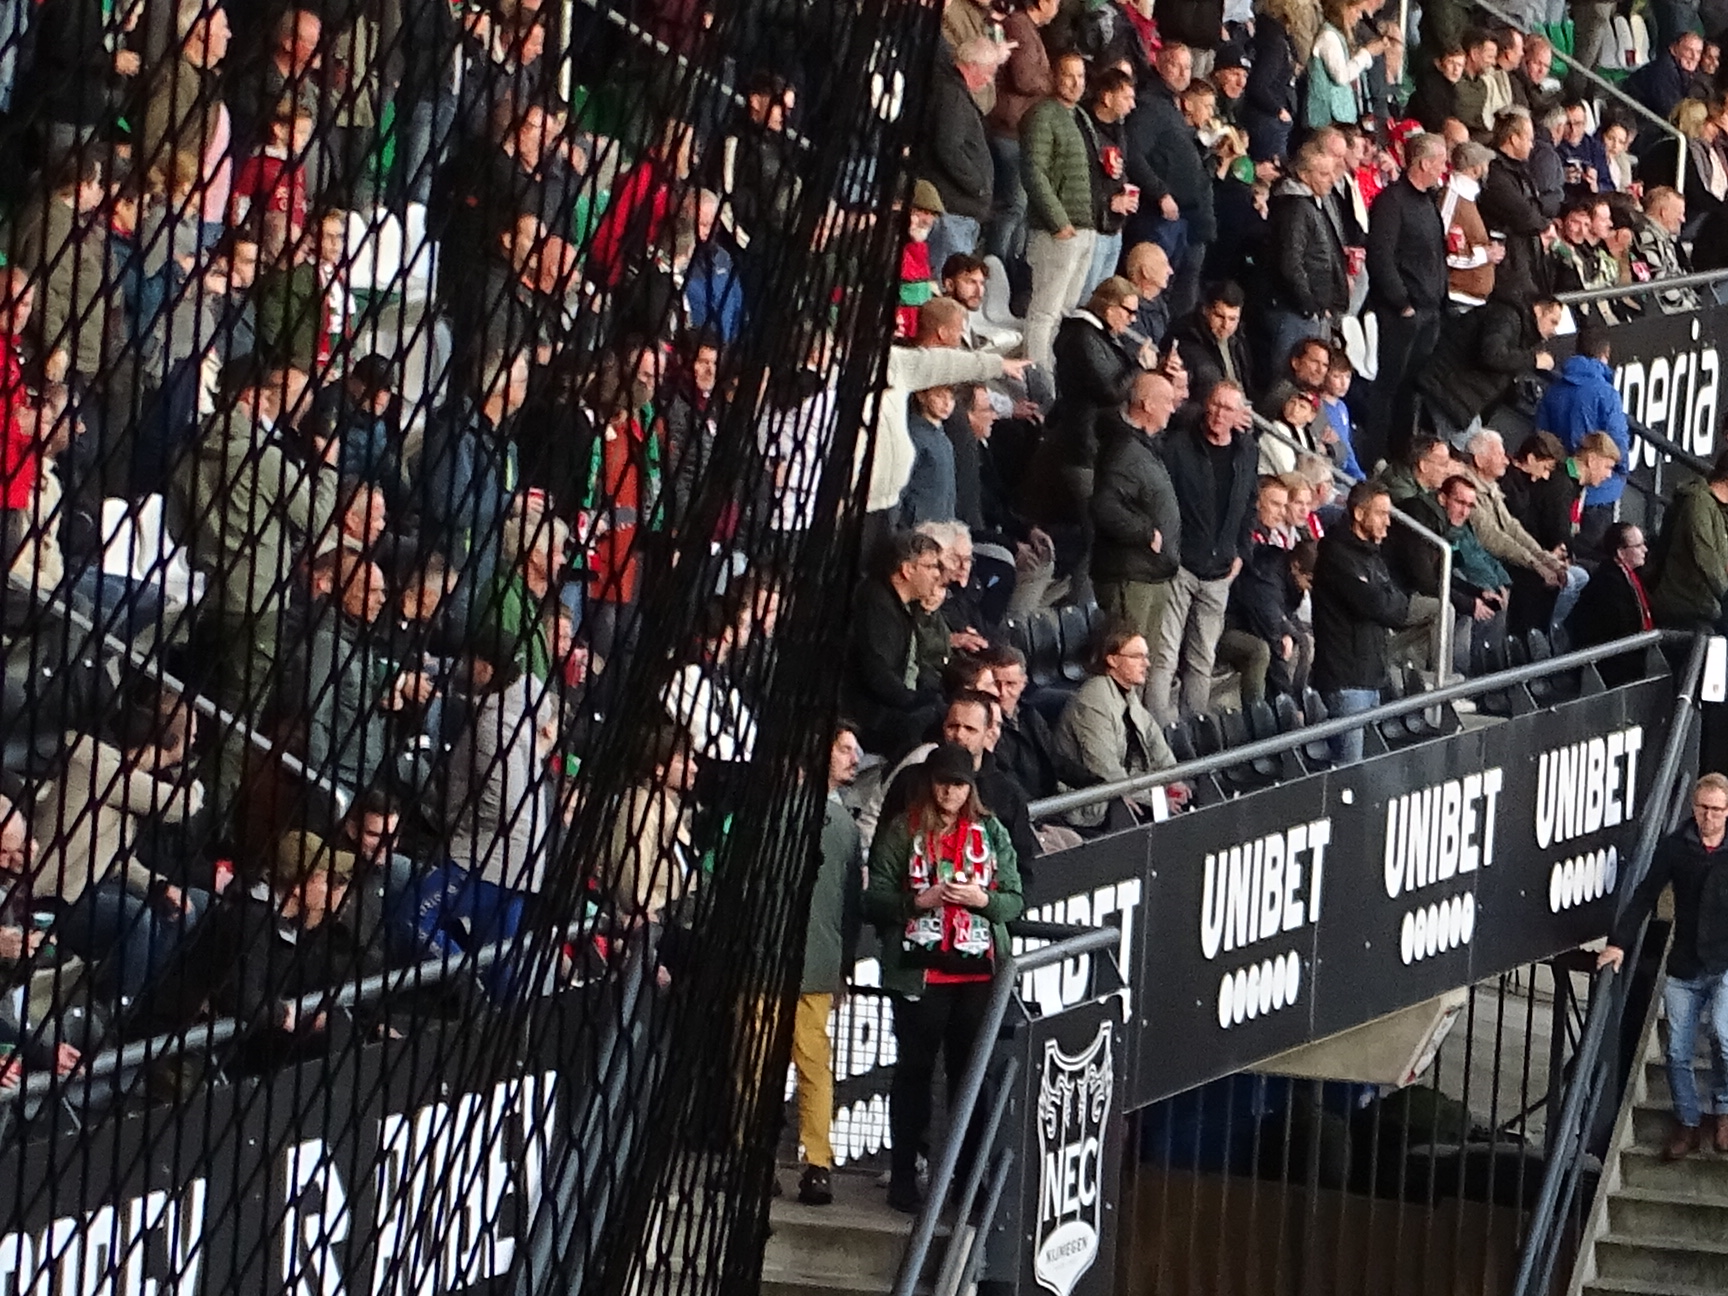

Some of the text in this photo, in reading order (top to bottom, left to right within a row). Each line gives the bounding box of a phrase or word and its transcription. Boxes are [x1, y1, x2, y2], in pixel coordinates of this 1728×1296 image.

[1385, 767, 1503, 899] UNIBET
[1535, 725, 1643, 850] UNIBET
[1201, 817, 1331, 960] UNIBET
[1042, 1137, 1098, 1222] NEC
